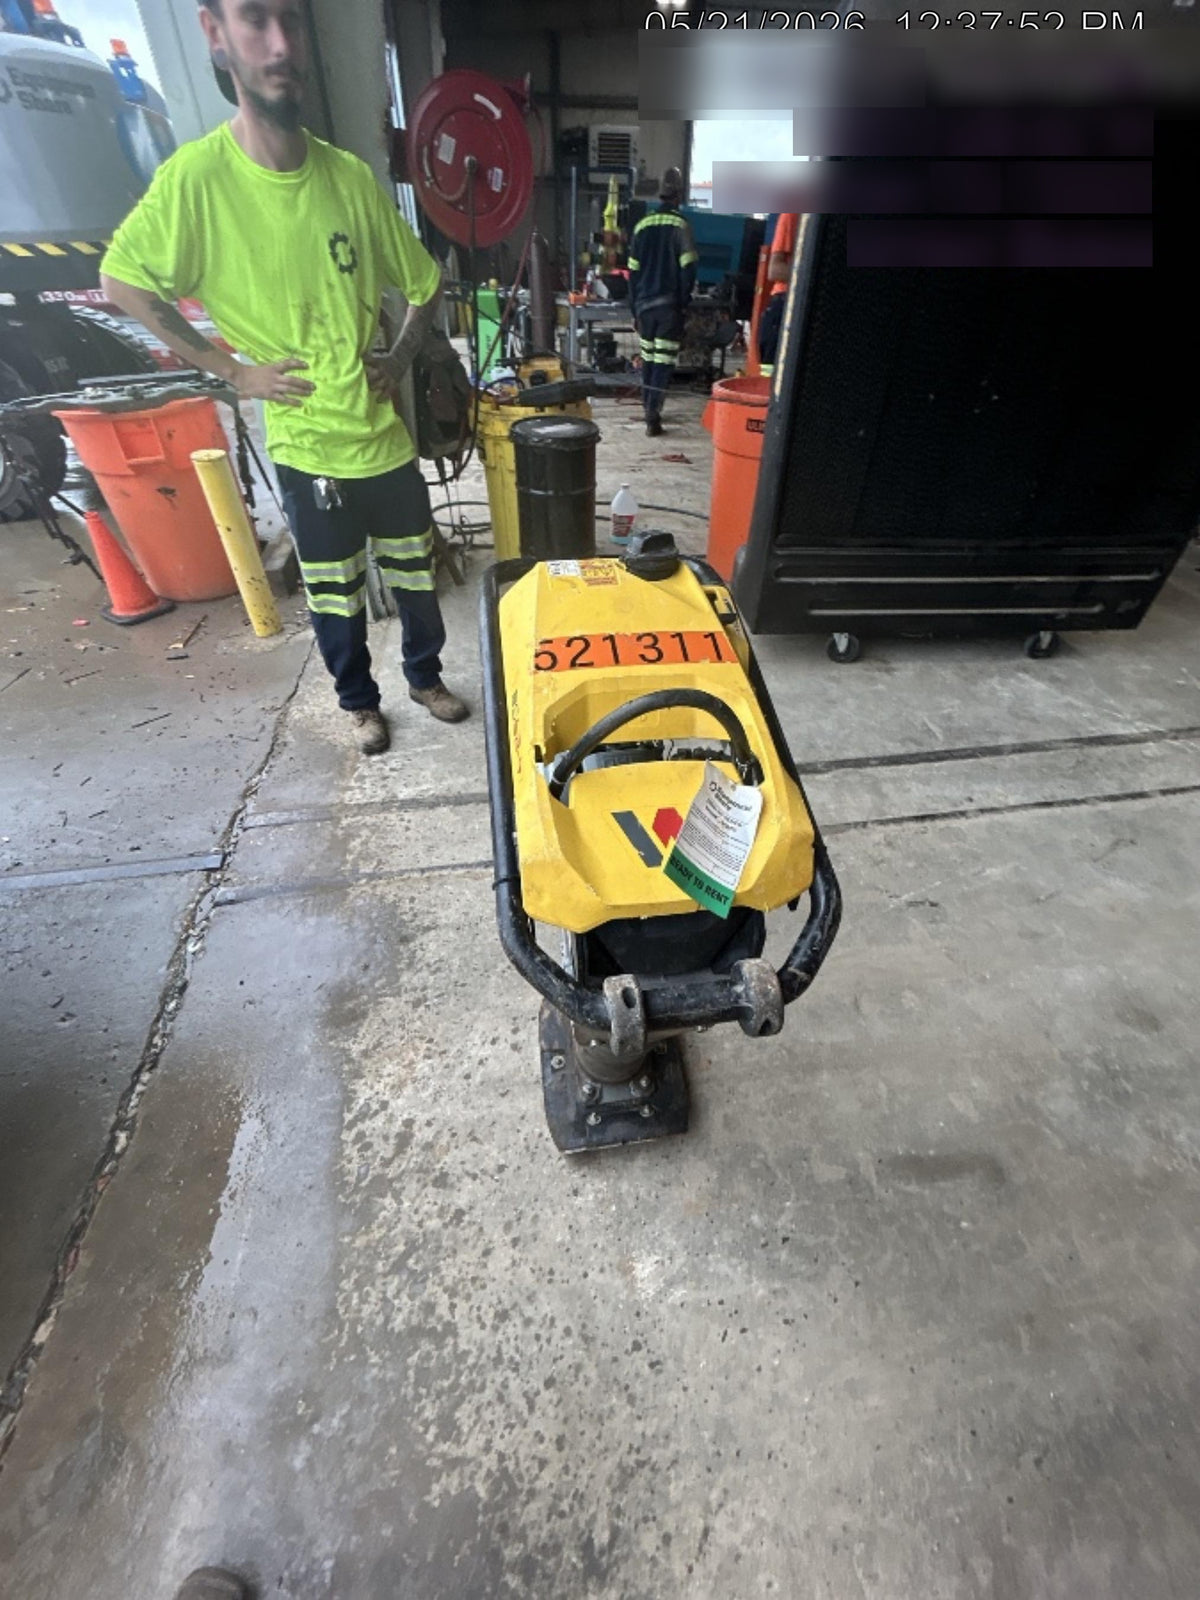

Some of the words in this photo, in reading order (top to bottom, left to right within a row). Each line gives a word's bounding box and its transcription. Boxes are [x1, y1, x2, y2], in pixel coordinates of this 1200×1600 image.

[534, 632, 722, 671] 521311
[670, 855, 694, 881] READY
[693, 876, 705, 890] TO
[705, 885, 730, 905] RENT
